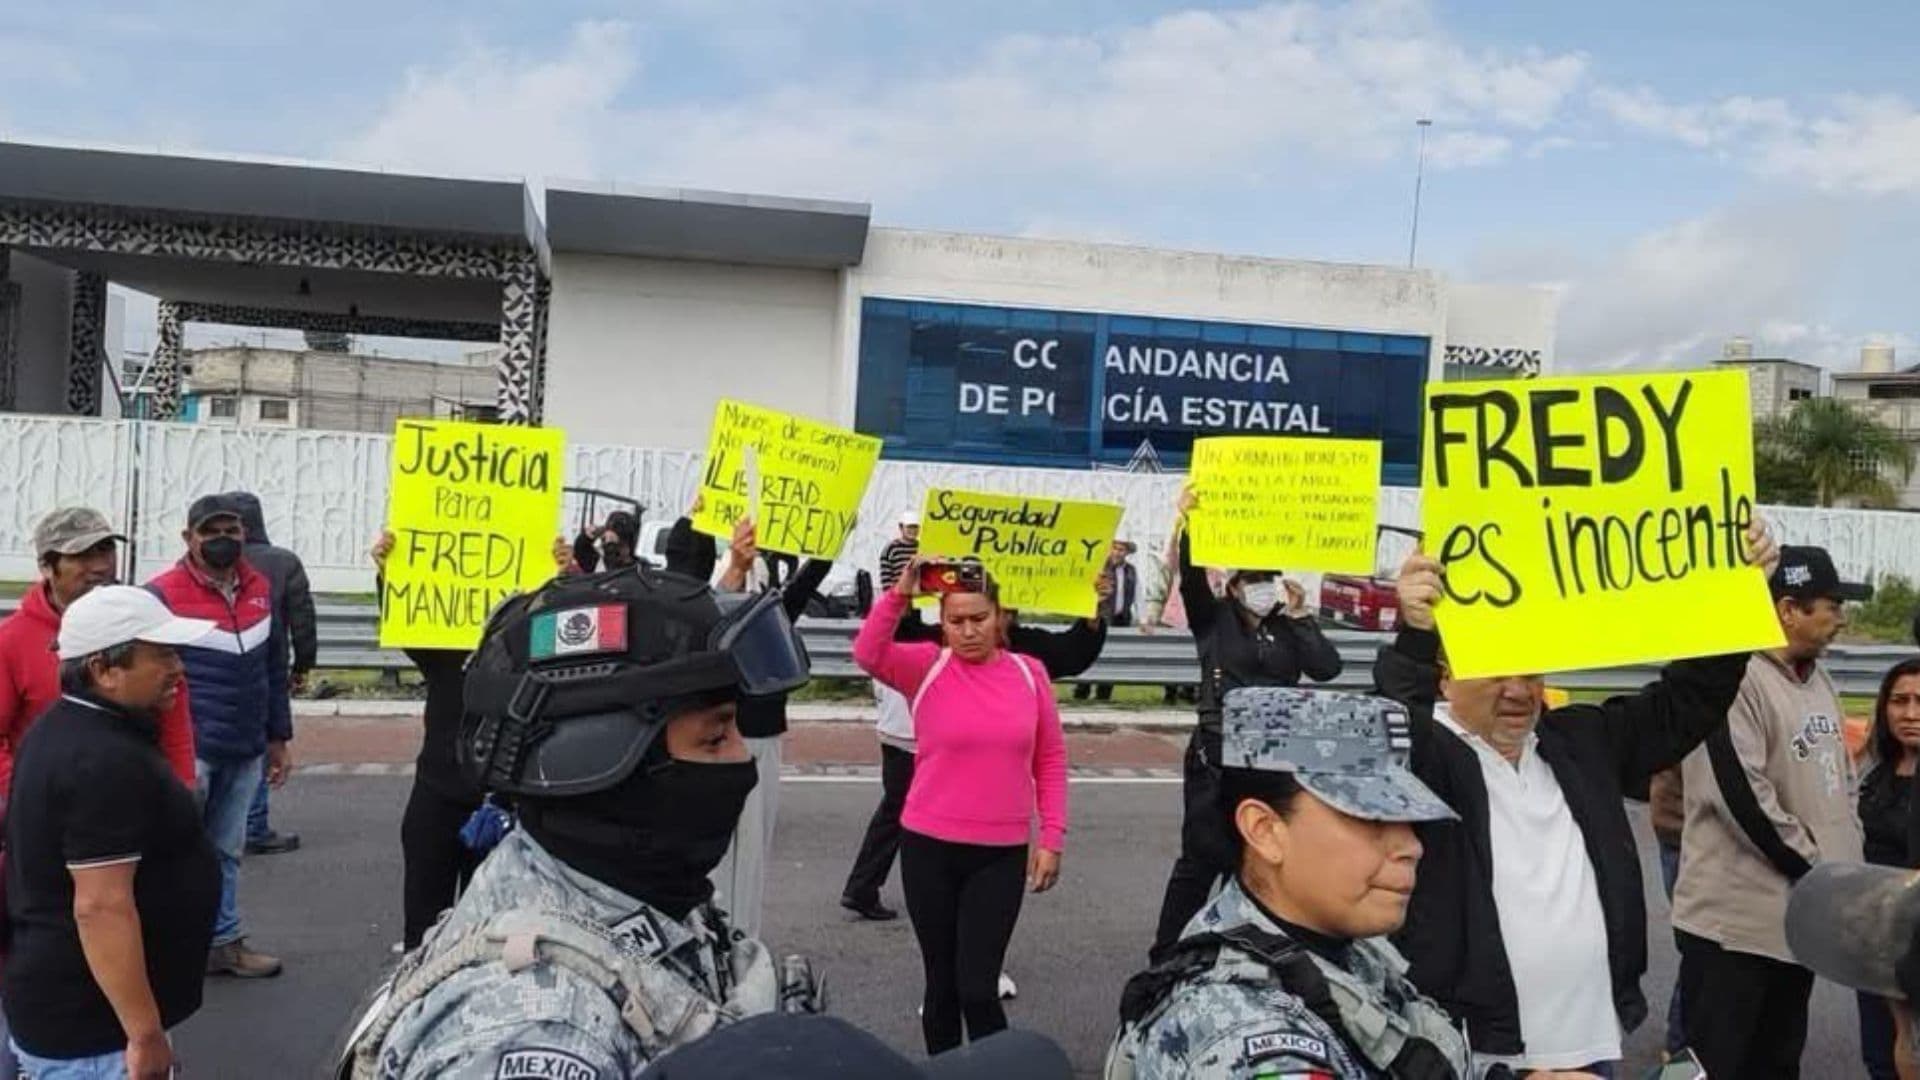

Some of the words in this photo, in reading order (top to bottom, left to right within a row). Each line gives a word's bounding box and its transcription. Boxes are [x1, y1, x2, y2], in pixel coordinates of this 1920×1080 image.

[1013, 338, 1290, 384] COANDANCIA
[959, 382, 1009, 414] DE
[1022, 386, 1168, 425] PCÍA
[1181, 396, 1330, 433] ESTATAL
[400, 423, 549, 492] Justicia
[1430, 379, 1693, 492] FREDY
[714, 501, 746, 526] PAR
[929, 491, 1062, 535] Seguridad
[400, 528, 525, 585] FREDI
[973, 526, 1067, 556] Publica
[1440, 523, 1522, 608] es
[1542, 467, 1753, 600] inocente
[504, 1055, 592, 1080] MEXICO
[1251, 1036, 1322, 1053] MEXICO
